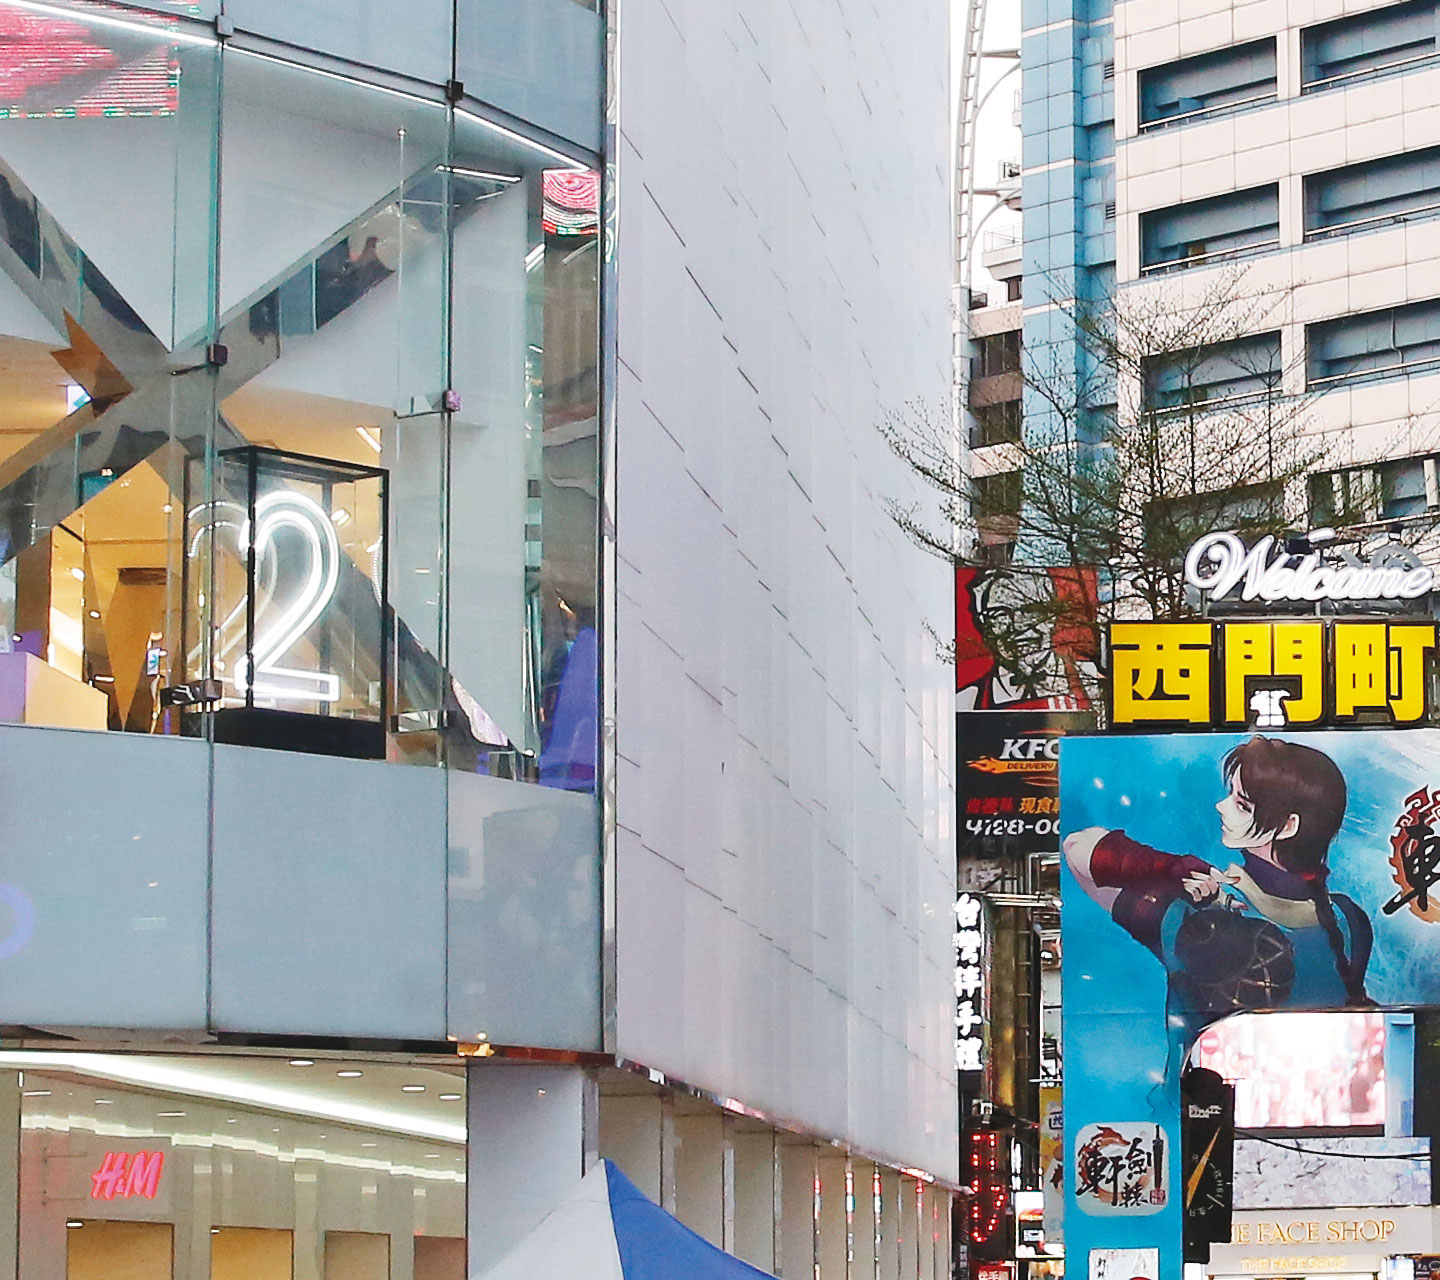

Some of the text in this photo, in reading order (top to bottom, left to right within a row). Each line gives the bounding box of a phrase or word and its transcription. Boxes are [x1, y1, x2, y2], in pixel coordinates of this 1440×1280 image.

[238, 487, 341, 703] 2
[1184, 531, 1433, 602] Welcome
[1110, 623, 1436, 725] 西門町
[1006, 762, 1055, 770] DELIVERY
[91, 1151, 164, 1200] H&M
[1258, 1222, 1321, 1245] FACE
[1326, 1220, 1396, 1242] SHOP
